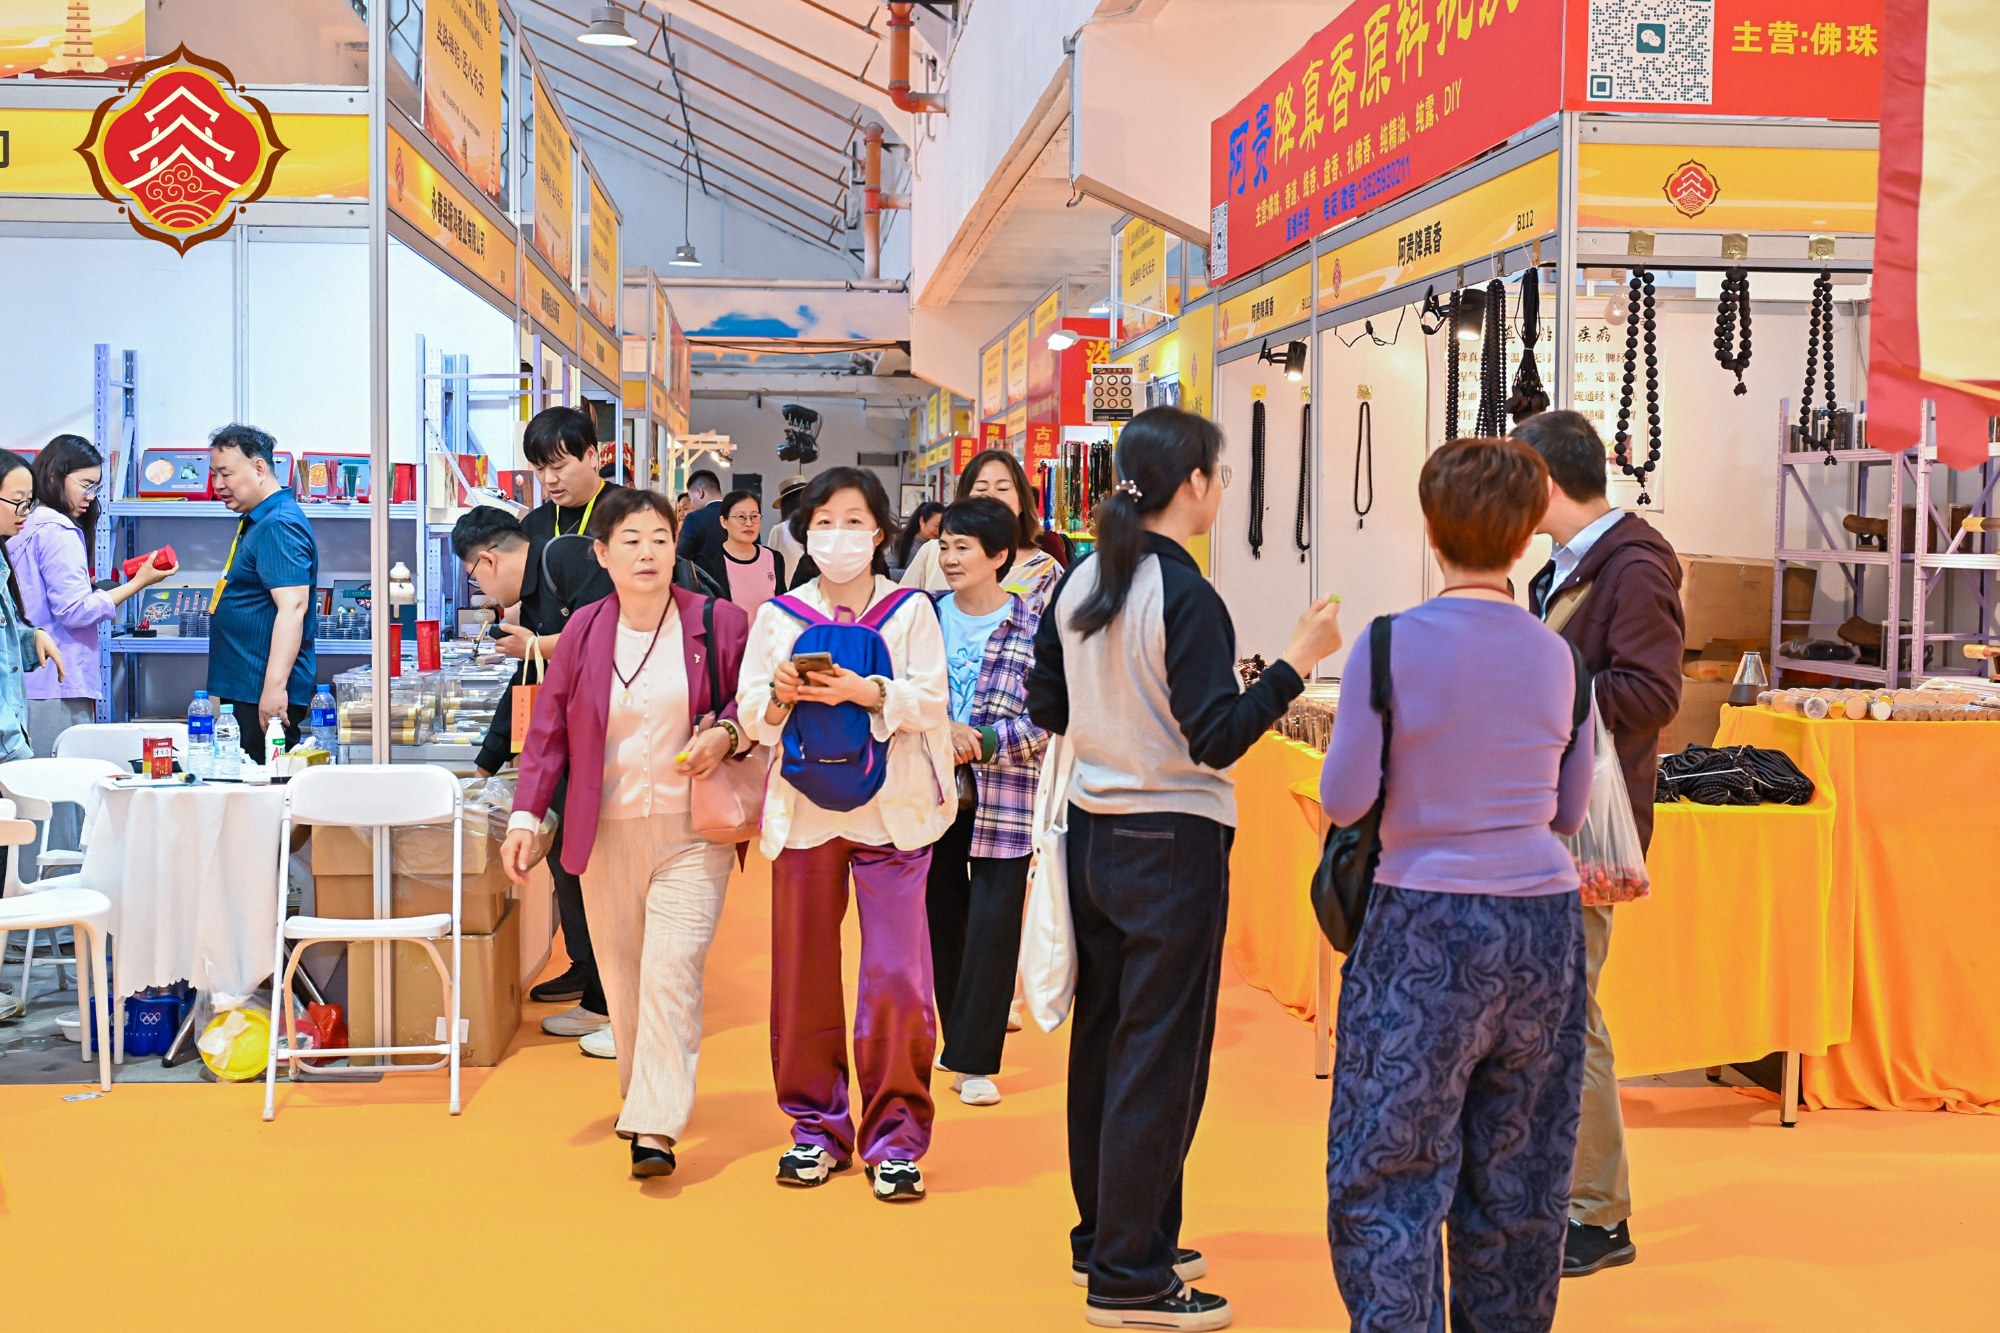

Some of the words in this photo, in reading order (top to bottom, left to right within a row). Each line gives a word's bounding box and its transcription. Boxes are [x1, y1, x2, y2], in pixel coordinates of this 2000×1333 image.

[1517, 209, 1534, 231] B112
[1398, 220, 1442, 268] 阿贵降真香
